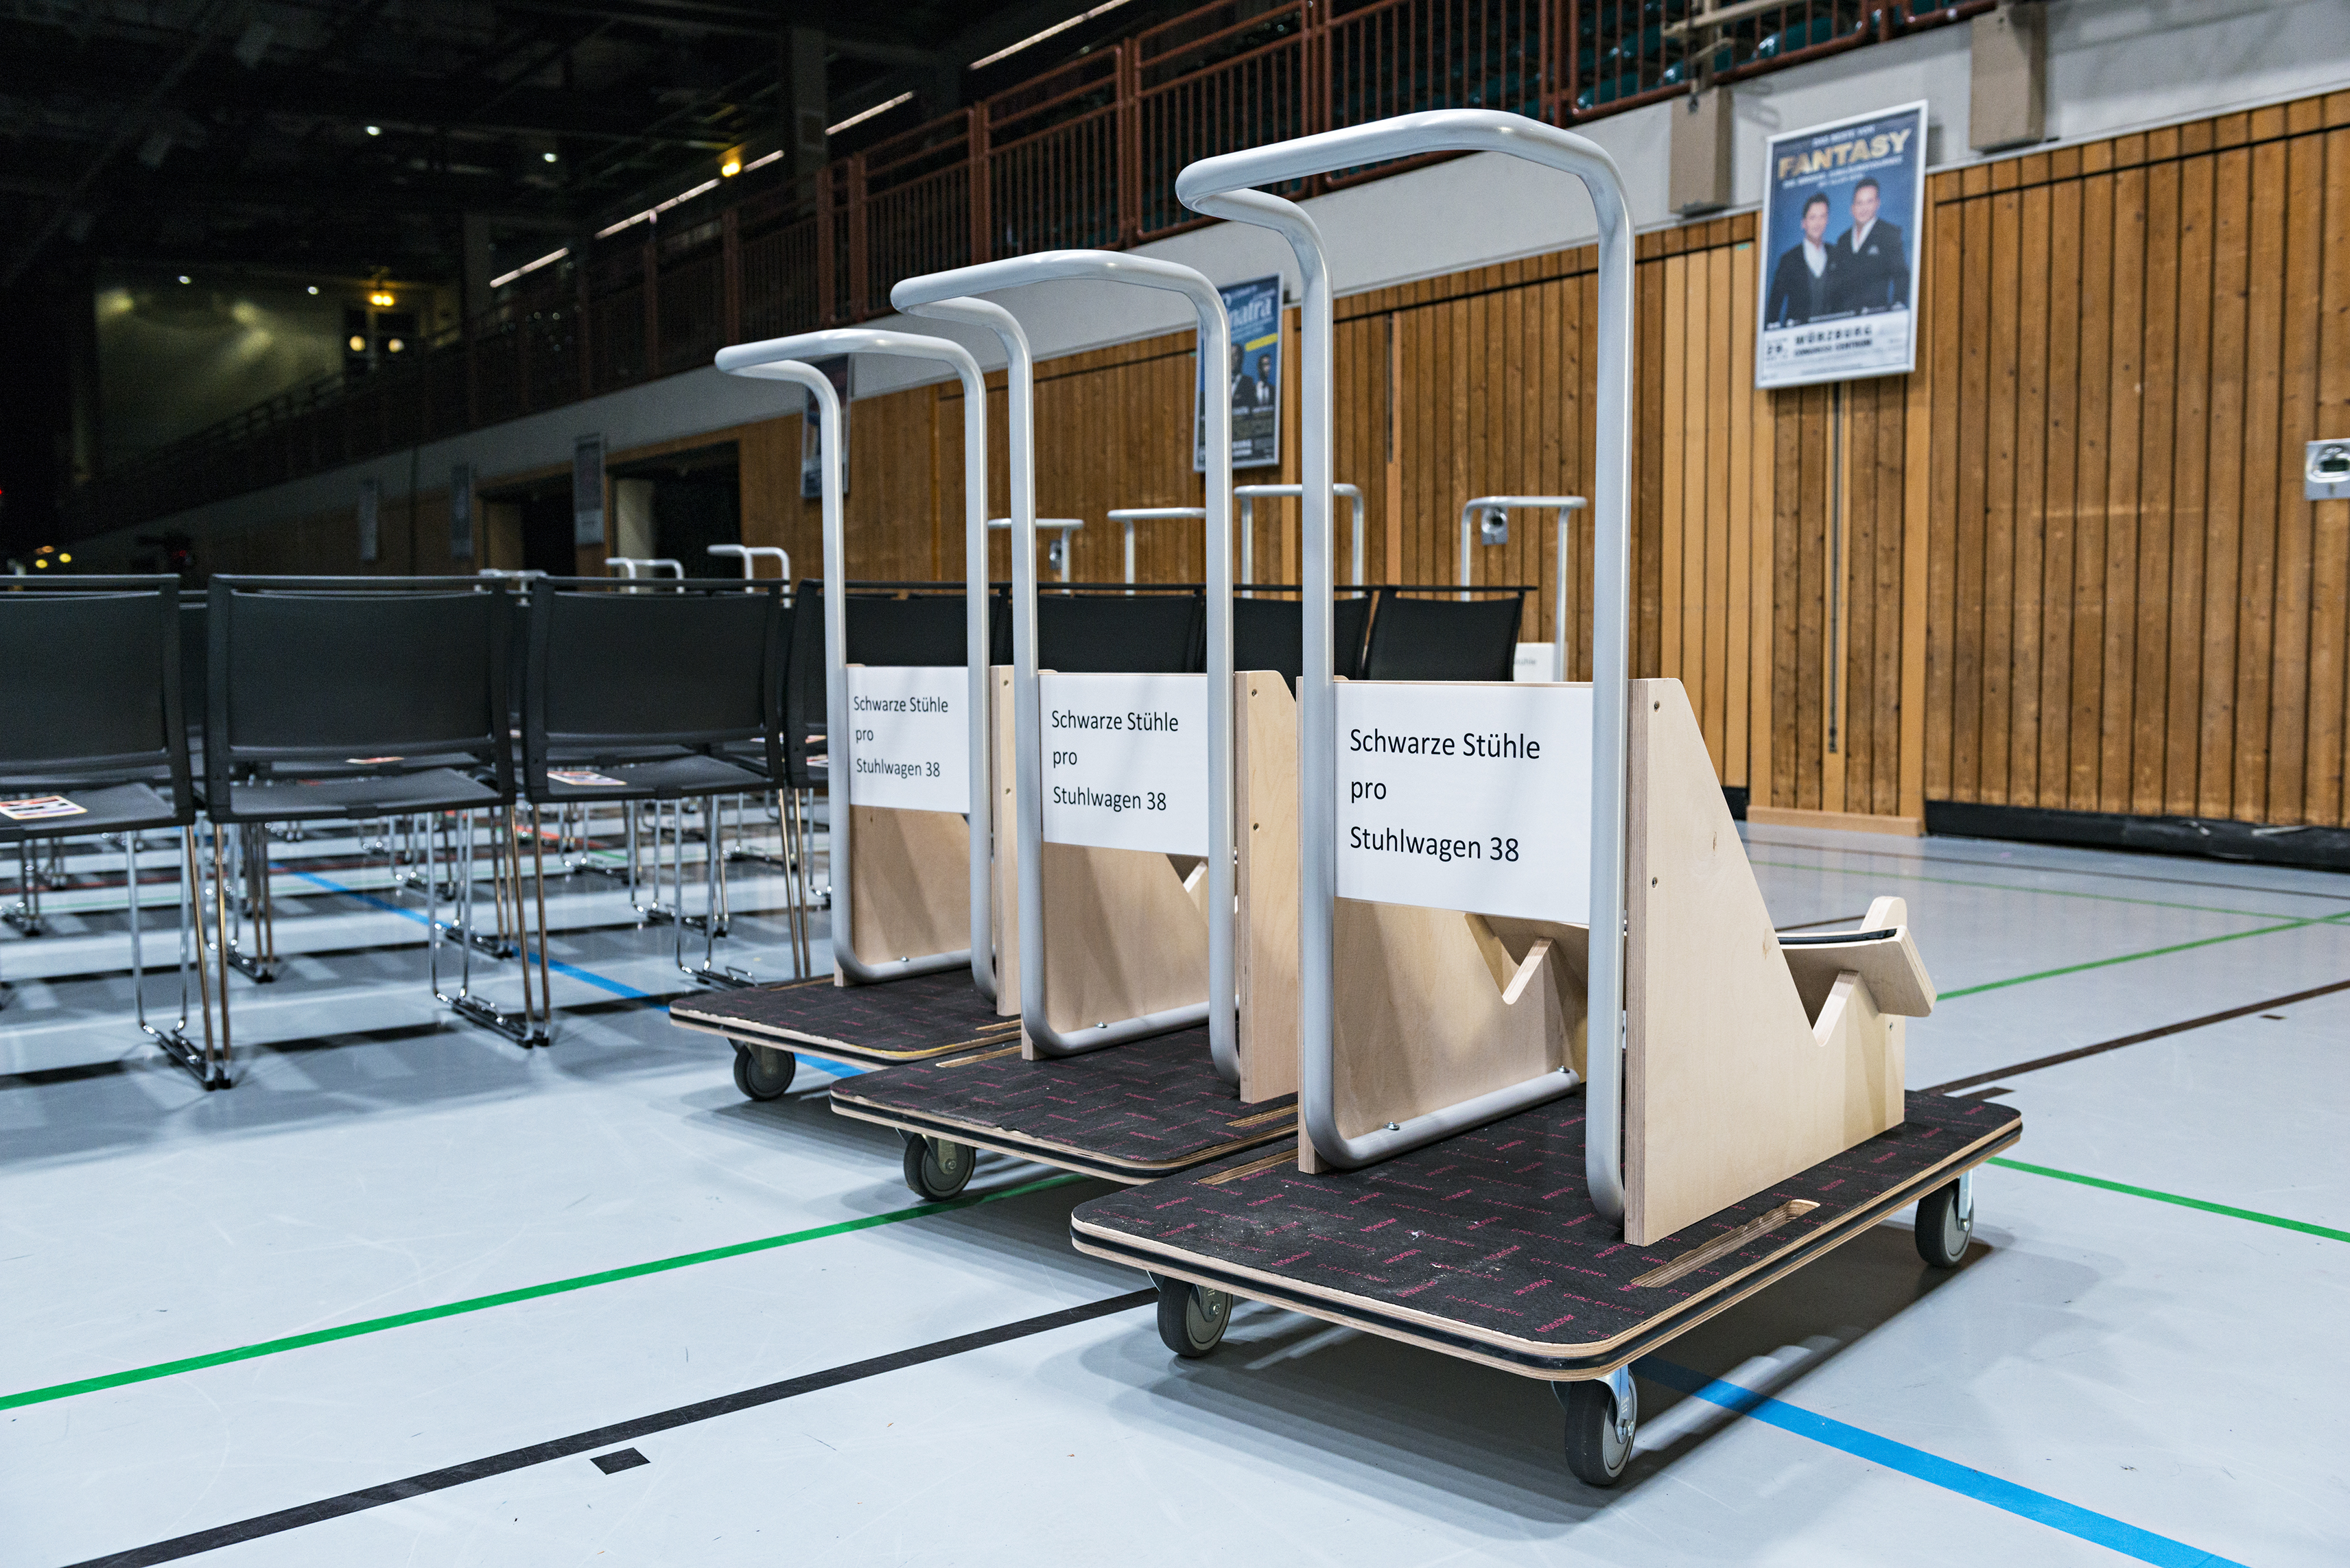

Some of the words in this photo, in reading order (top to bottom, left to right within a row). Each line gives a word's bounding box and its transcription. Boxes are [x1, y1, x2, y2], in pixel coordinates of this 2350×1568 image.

[1778, 128, 1912, 180] FANTASY
[854, 696, 906, 712] Schwarze
[910, 697, 949, 713] Stühle
[1051, 709, 1123, 730] Schwarze
[1127, 711, 1179, 732] Stühle
[856, 729, 874, 744] pro
[1350, 728, 1455, 756] Schwarze
[1463, 733, 1540, 759] Stühle
[856, 758, 922, 779] Stuhlwagen
[926, 761, 941, 778] 38
[1053, 750, 1077, 768] pro
[1053, 786, 1141, 812] Stuhlwagen
[1147, 792, 1166, 811] 38
[1351, 781, 1387, 804] pro
[1350, 826, 1481, 863] Stuhlwagen
[1490, 837, 1520, 862] 38
